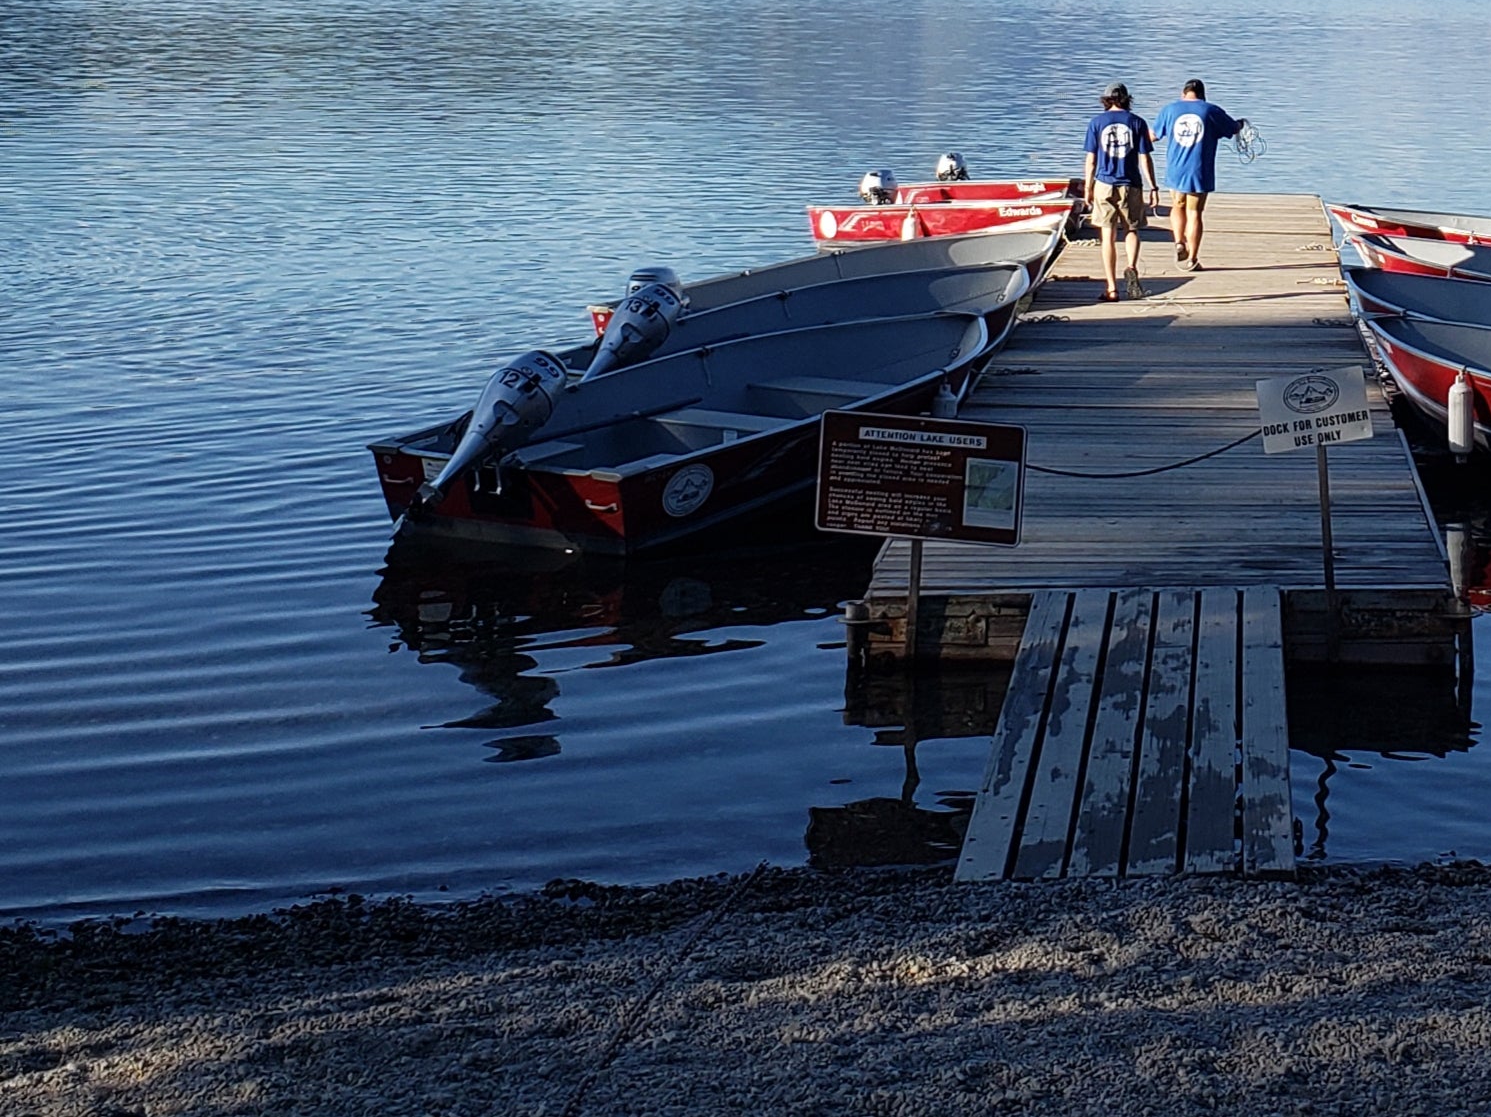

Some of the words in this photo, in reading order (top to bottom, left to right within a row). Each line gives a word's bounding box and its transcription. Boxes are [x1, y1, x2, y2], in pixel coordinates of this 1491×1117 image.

[998, 205, 1043, 218] Edwards
[625, 299, 643, 313] 13
[498, 370, 520, 389] 12
[1263, 422, 1290, 437] DOCK
[1293, 419, 1313, 432] FOR
[1315, 410, 1369, 428] CUSTOMER
[864, 429, 916, 441] ATTENTION
[920, 433, 944, 443] LAKE
[948, 435, 983, 447] USERS
[1294, 435, 1314, 447] USE
[1317, 430, 1342, 444] ONLY
